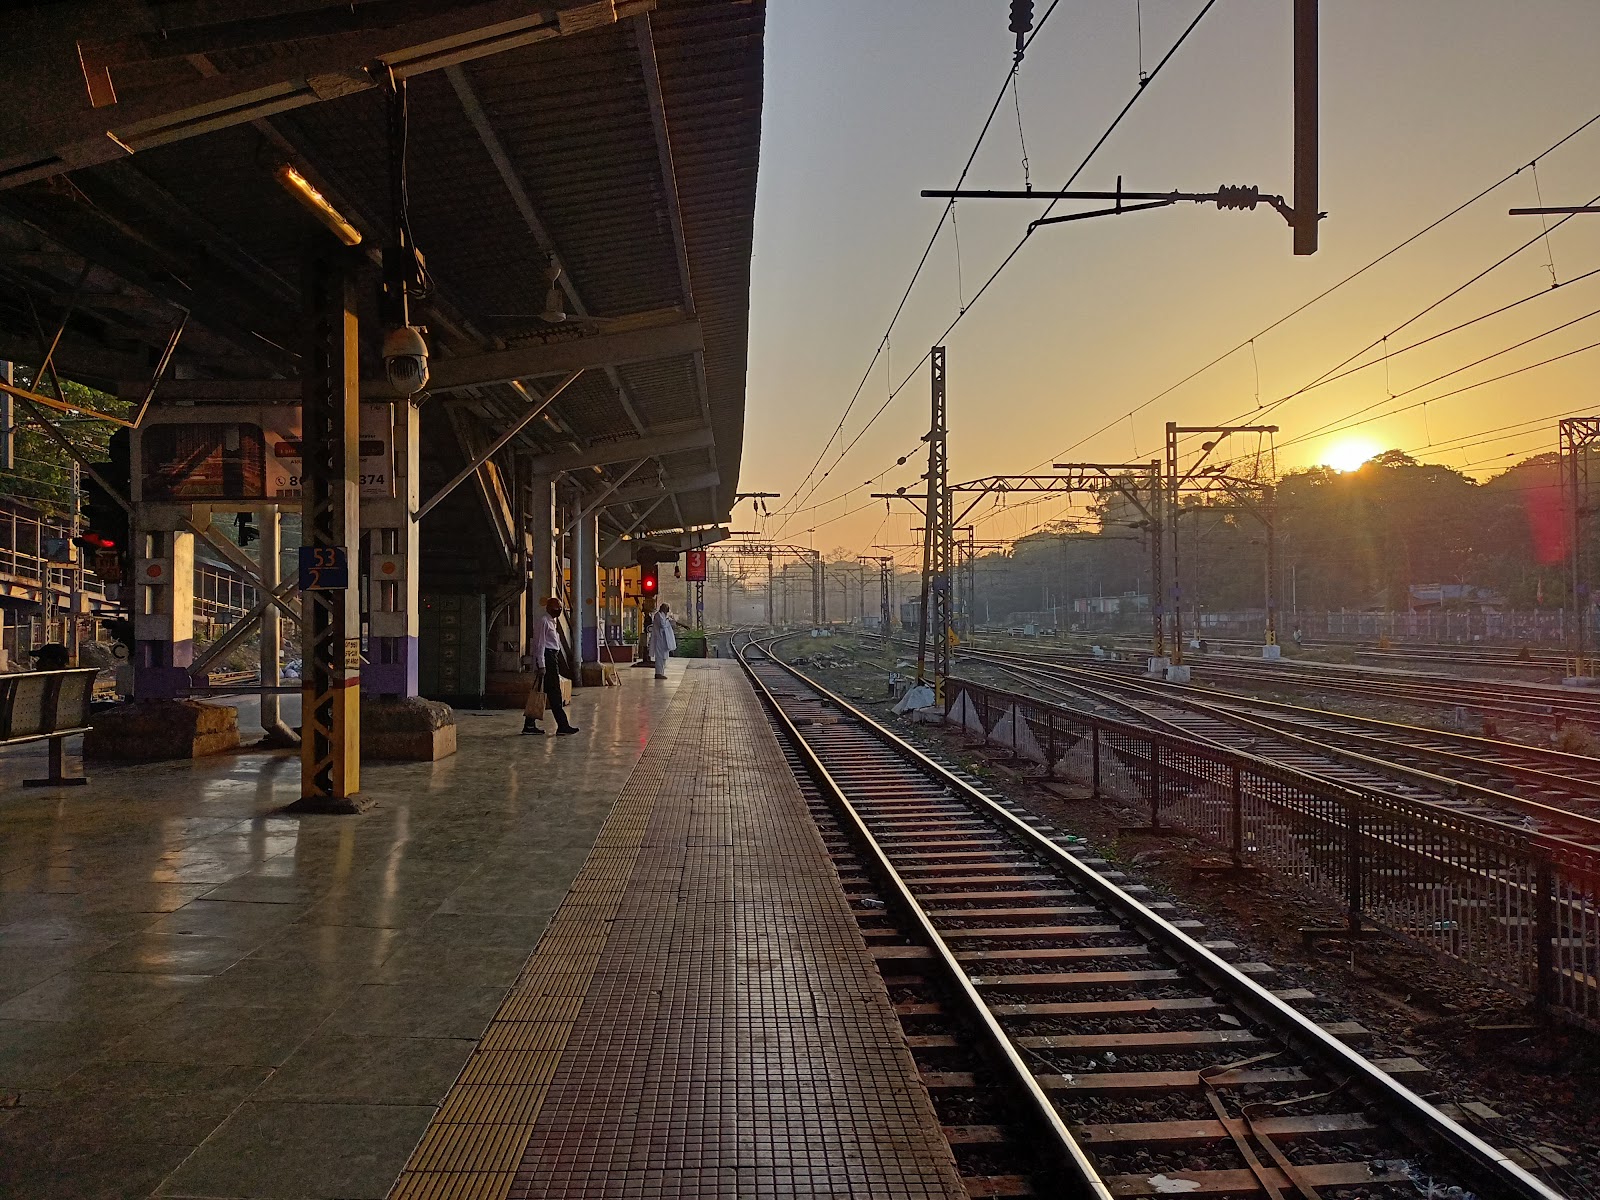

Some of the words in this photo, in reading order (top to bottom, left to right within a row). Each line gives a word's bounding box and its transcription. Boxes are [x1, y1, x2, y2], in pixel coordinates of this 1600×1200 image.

[314, 548, 336, 567] 53
[691, 552, 702, 568] 3
[309, 570, 321, 589] 2
